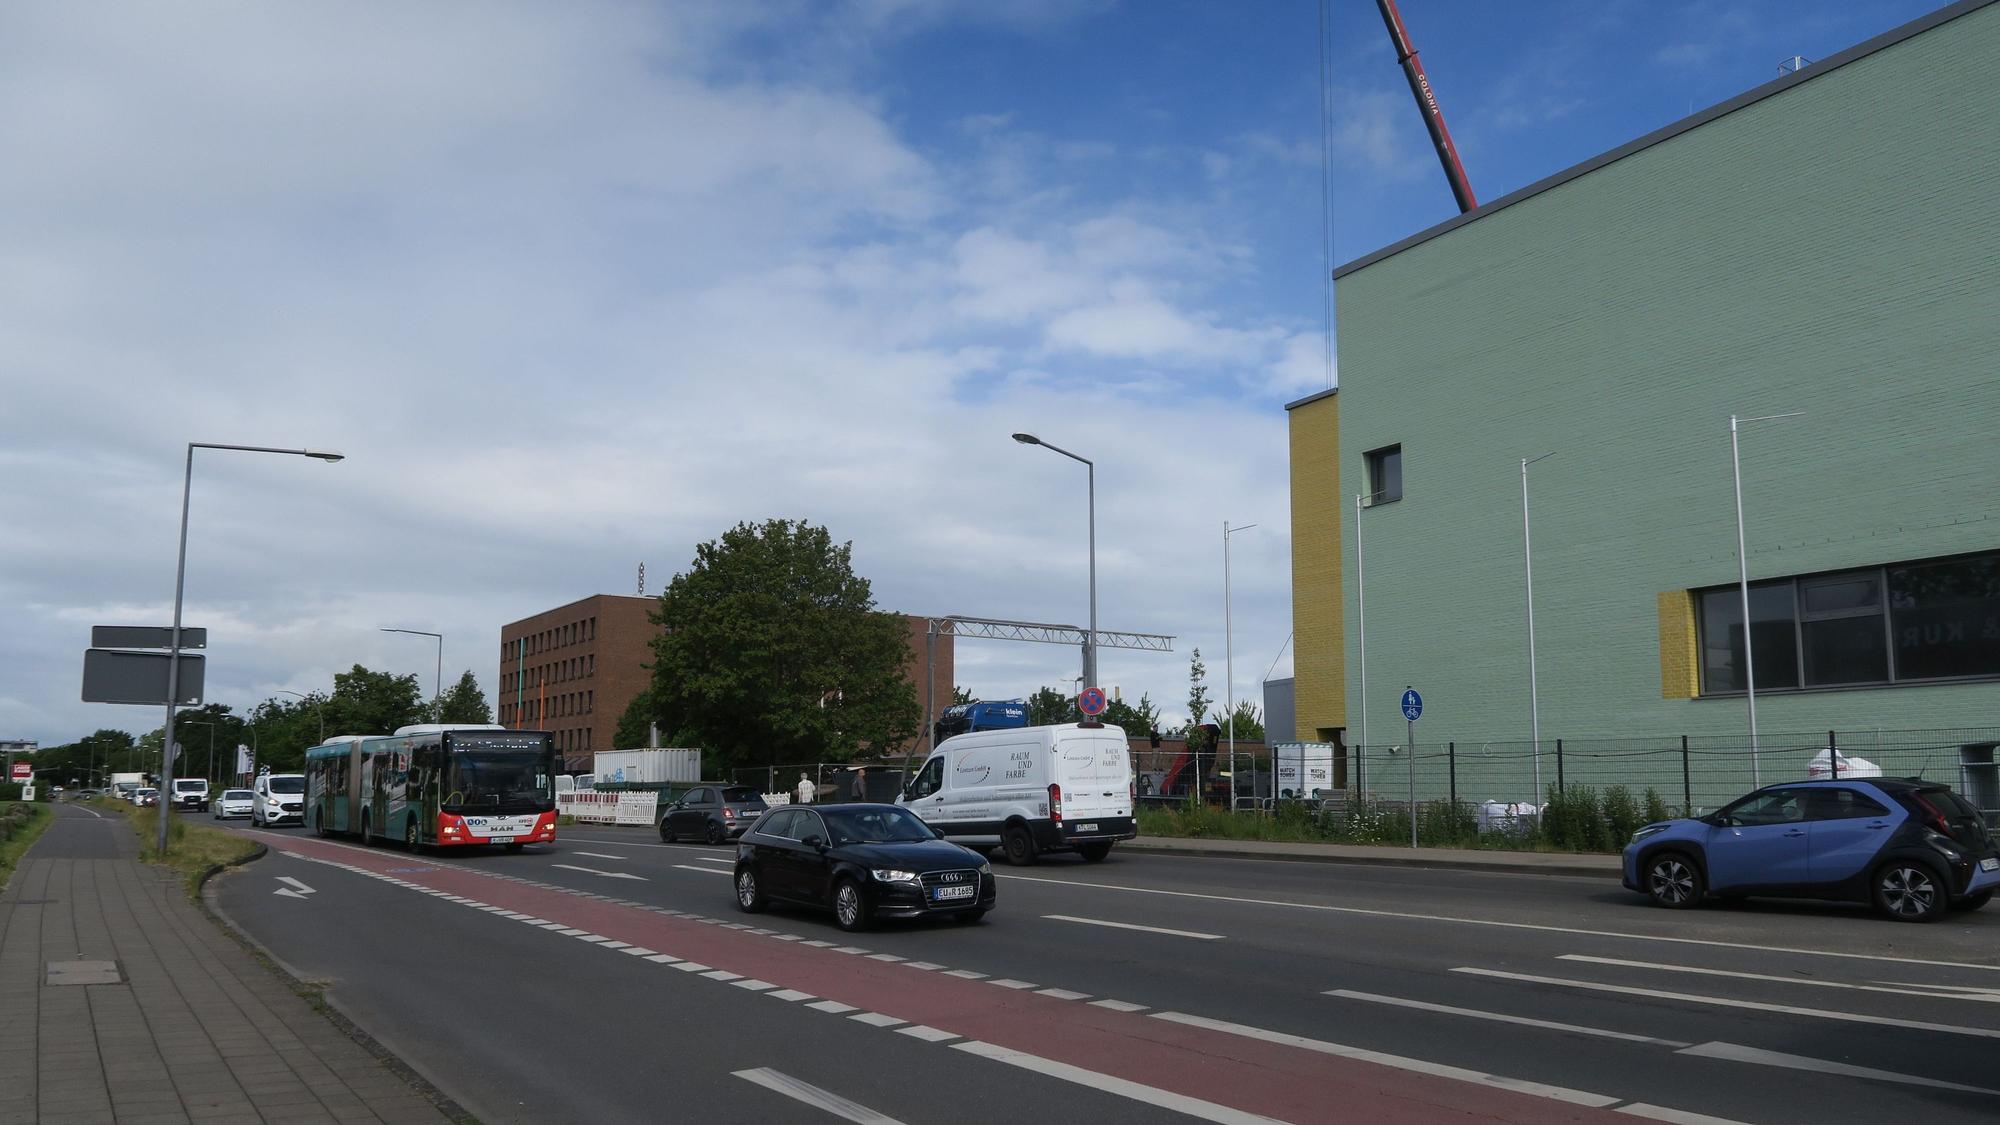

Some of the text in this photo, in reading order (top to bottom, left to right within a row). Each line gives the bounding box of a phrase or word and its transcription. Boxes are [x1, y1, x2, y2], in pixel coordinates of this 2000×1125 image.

[1418, 74, 1438, 115] COLONIA
[1005, 708, 1023, 716] klein
[1010, 752, 1030, 760] RAUM
[1017, 760, 1033, 769] UND
[1005, 770, 1027, 779] FARBE
